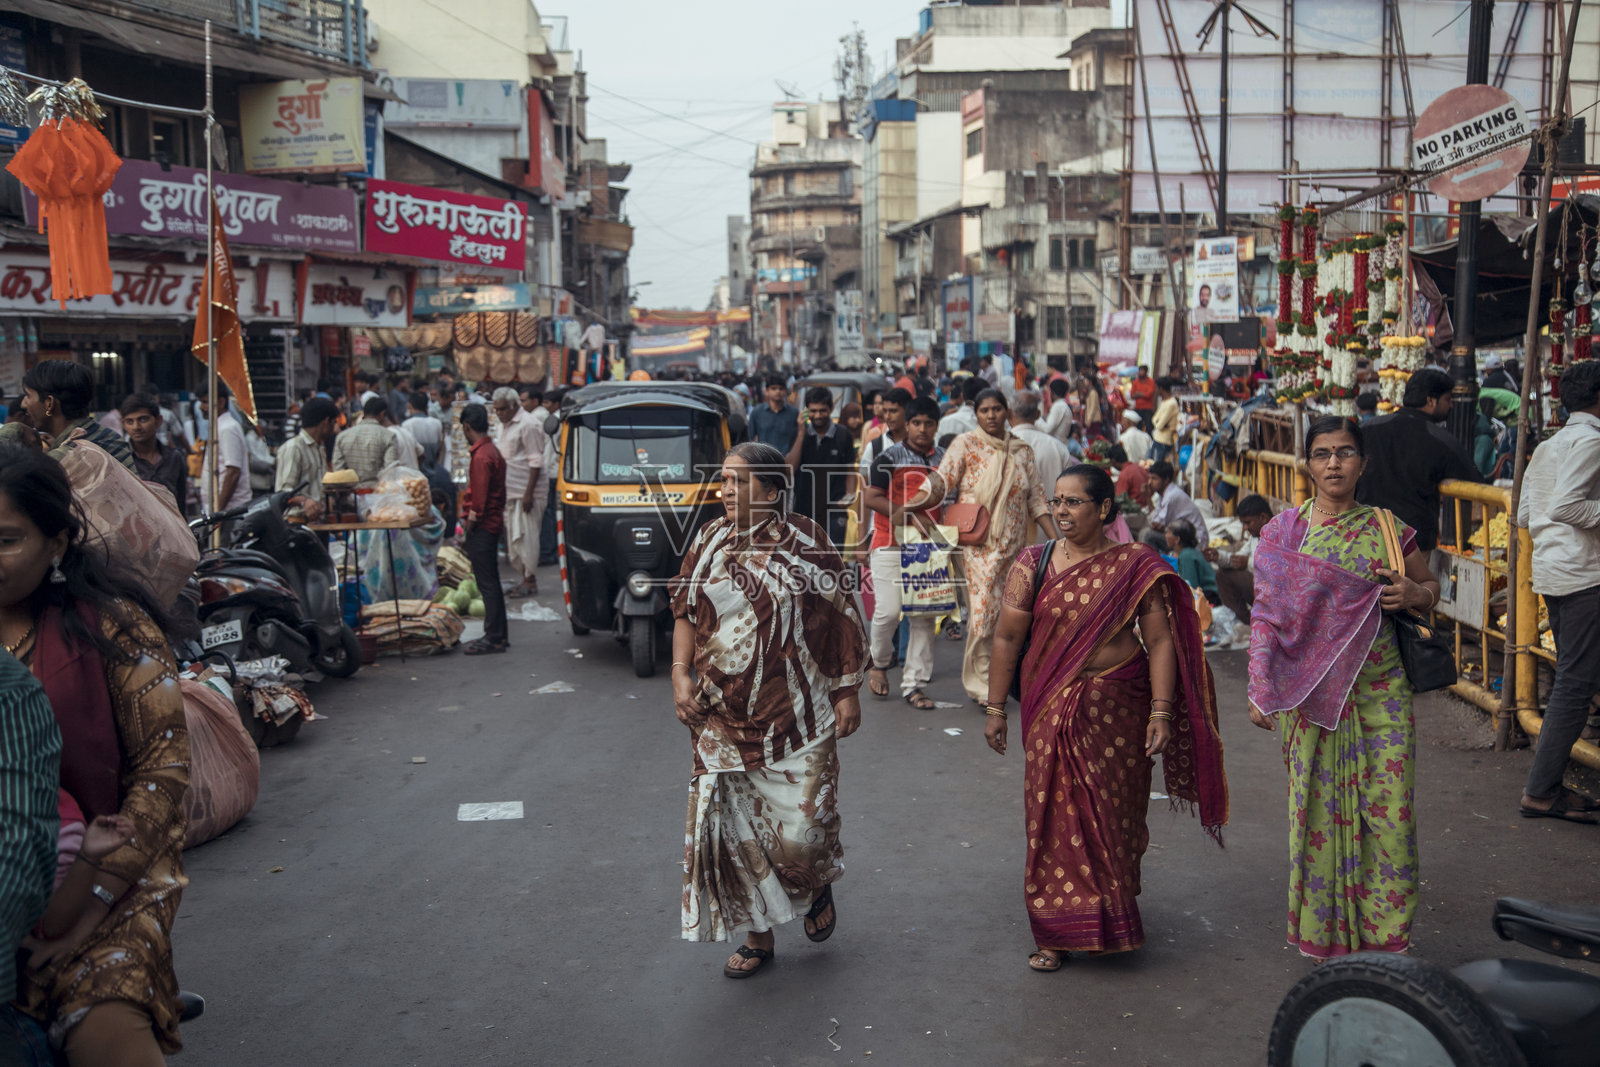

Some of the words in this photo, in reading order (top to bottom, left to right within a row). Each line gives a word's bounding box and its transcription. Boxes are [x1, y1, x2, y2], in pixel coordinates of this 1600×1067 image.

[272, 82, 328, 136] दुर्गा
[1416, 140, 1439, 160] NO
[1441, 107, 1518, 149] PARKING
[139, 173, 207, 232] दुर्गा
[212, 184, 282, 236] भुवन
[917, 588, 953, 600] SELECTION
[205, 630, 239, 646] 8028
